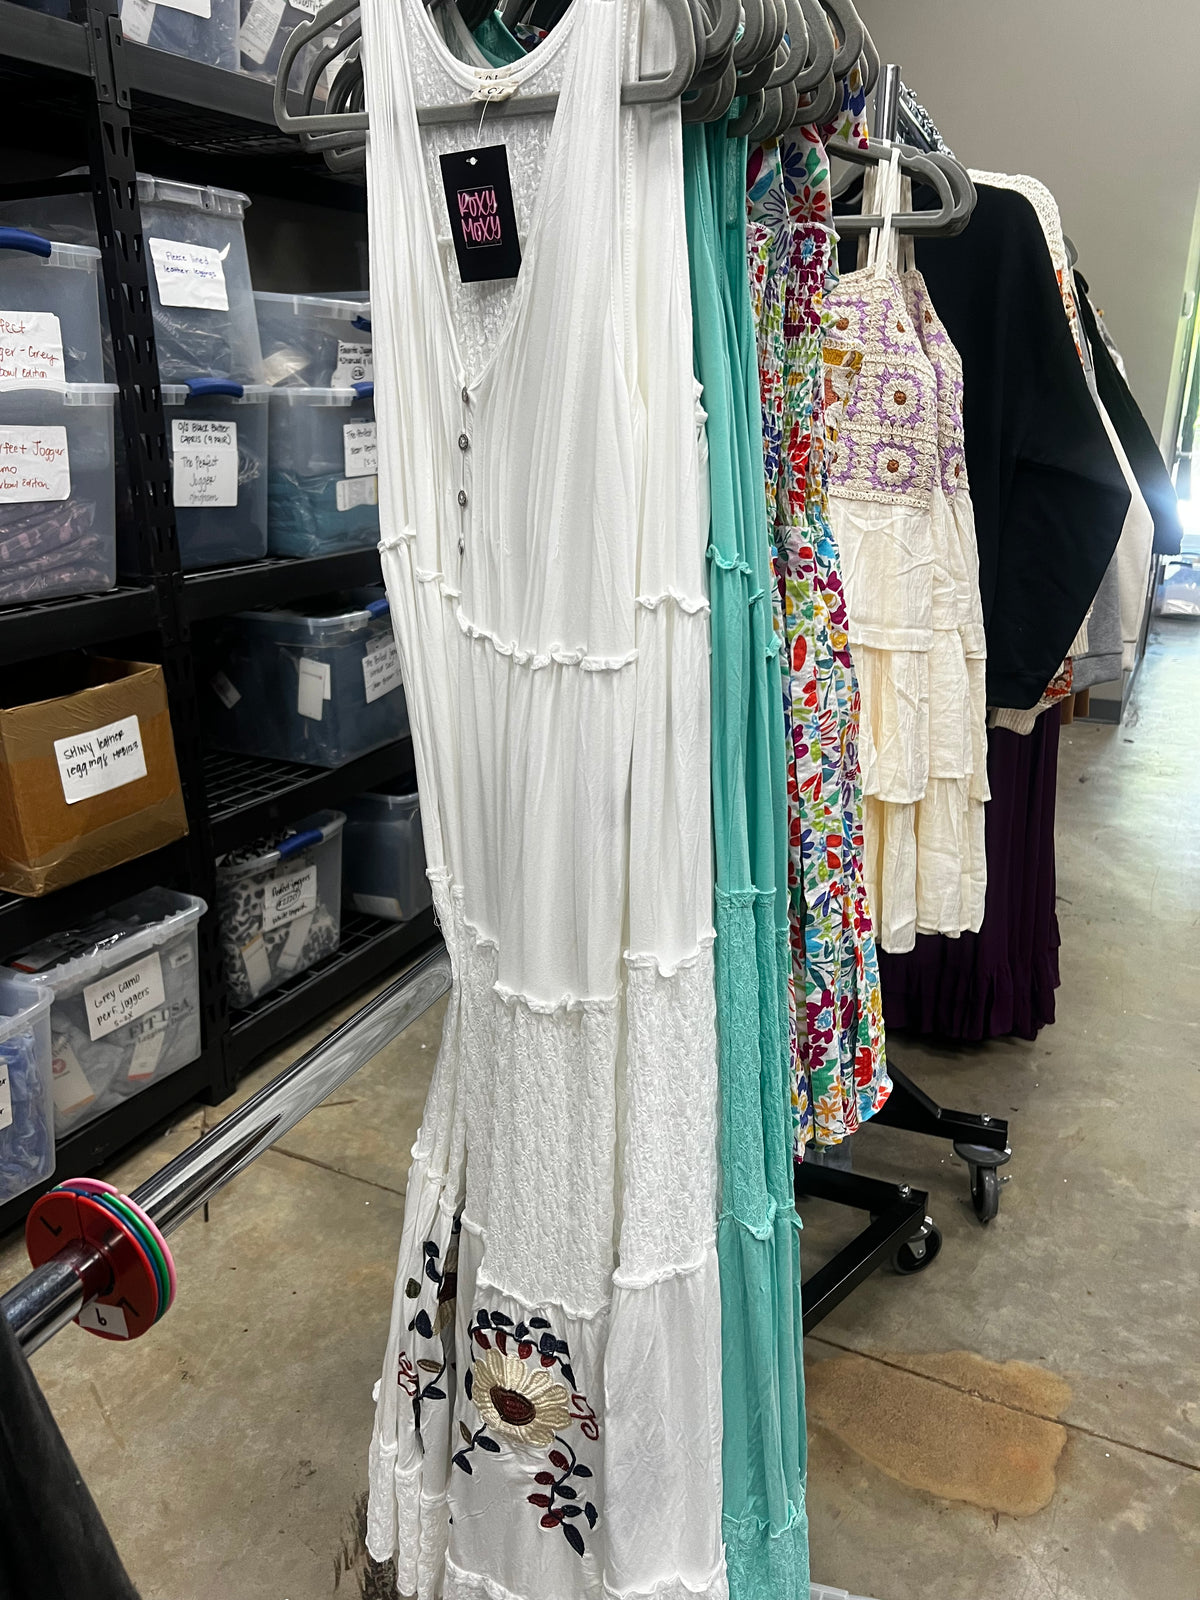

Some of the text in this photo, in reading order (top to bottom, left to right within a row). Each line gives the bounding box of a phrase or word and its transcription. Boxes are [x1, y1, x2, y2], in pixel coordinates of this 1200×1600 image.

[458, 190, 497, 217] ROXY
[461, 215, 501, 242] MOXY
[28, 345, 60, 366] Grey
[63, 741, 96, 761] SHINY
